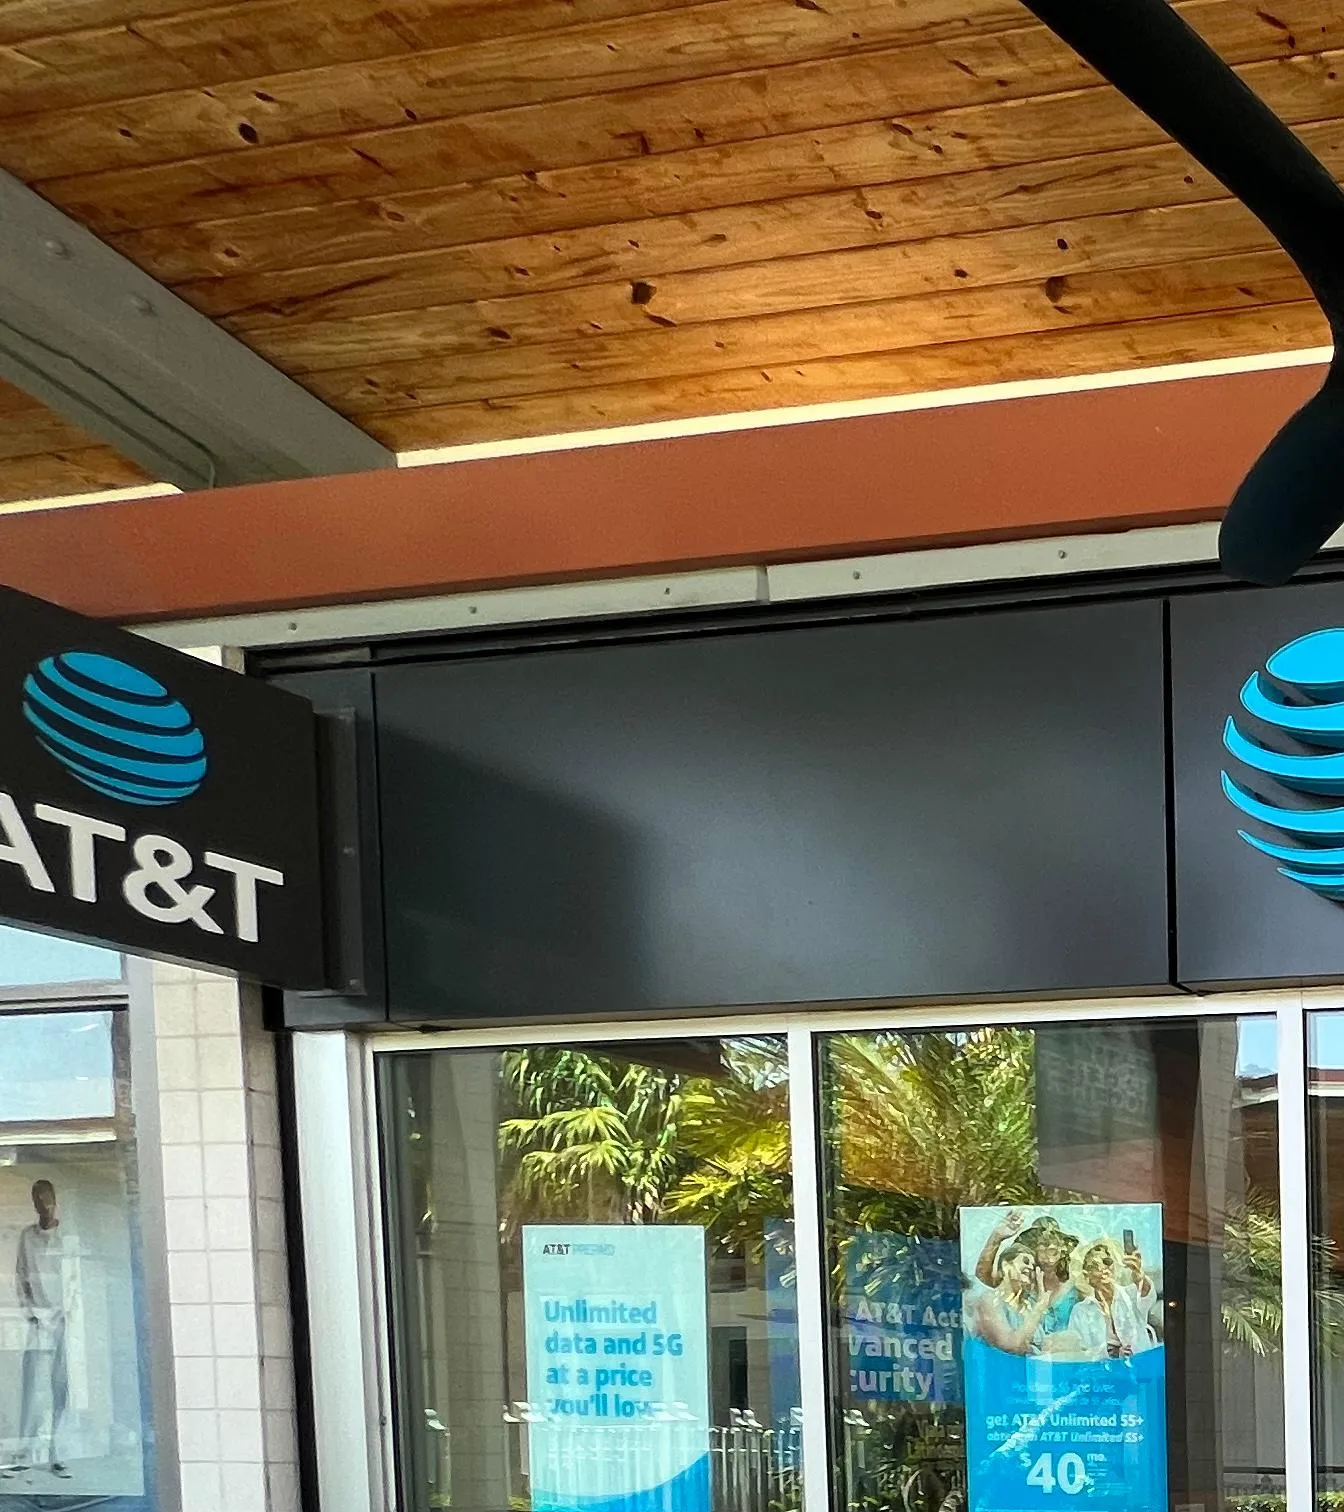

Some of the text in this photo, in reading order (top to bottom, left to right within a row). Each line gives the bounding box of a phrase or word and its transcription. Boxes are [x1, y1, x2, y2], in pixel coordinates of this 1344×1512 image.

[543, 1243, 571, 1256] AT&T
[544, 1299, 657, 1325] Unlimited
[855, 1298, 917, 1326] AT&T
[545, 1330, 684, 1357] data and 5G
[849, 1332, 954, 1361] vanced
[546, 1362, 653, 1391] at a price
[615, 1394, 663, 1418] lov
[985, 1413, 1008, 1429] get
[1050, 1412, 1117, 1427] Unlimited
[1039, 1431, 1069, 1443] AT&T
[1070, 1431, 1123, 1443] Unlimited
